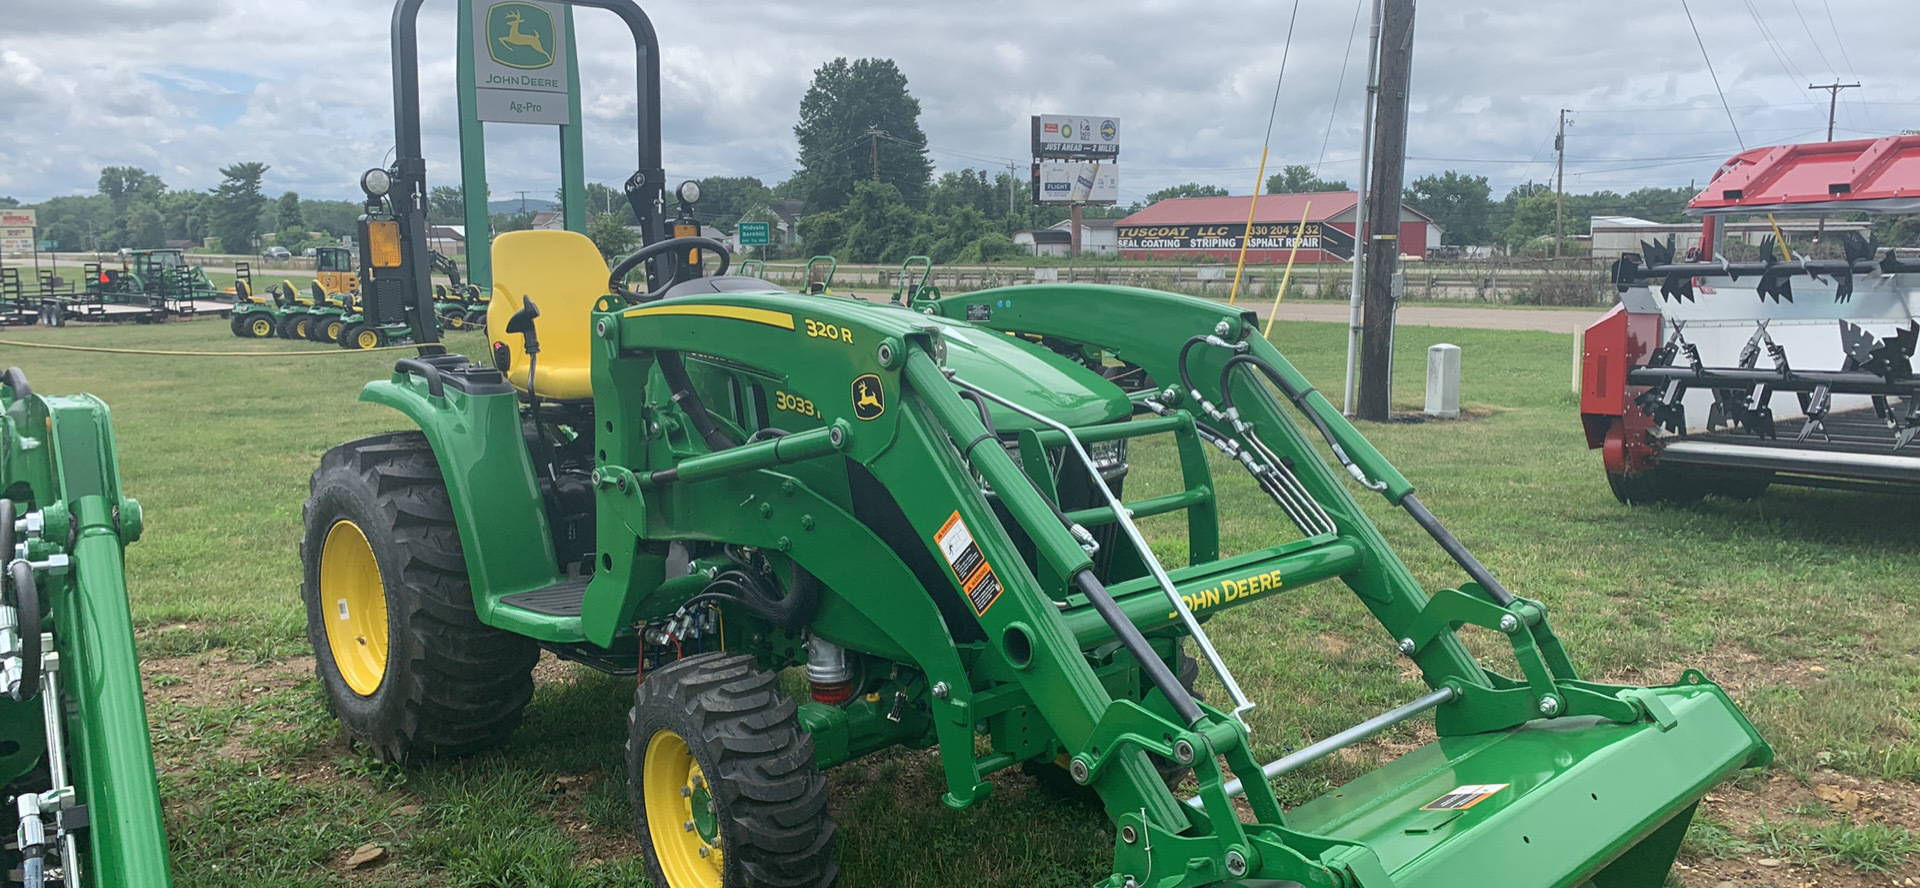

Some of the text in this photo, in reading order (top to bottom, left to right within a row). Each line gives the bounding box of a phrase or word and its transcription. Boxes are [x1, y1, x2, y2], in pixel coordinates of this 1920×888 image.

[486, 74, 559, 88] JOHN DEERE
[510, 101, 542, 113] Ag-Pro
[1045, 143, 1062, 151] JUST
[1061, 144, 1083, 152] AHEAD
[1119, 227, 1190, 237] TUSCOAT
[1197, 227, 1229, 236] LLC
[1249, 226, 1268, 235] 330
[1270, 225, 1290, 235] 204
[1117, 239, 1139, 248] SEAL
[1141, 238, 1181, 248] COATING
[1190, 238, 1237, 248] STRIPING
[1246, 238, 1285, 247] ASPHALT
[804, 318, 854, 344] 320 R
[1168, 569, 1283, 619] OHN DEERE
